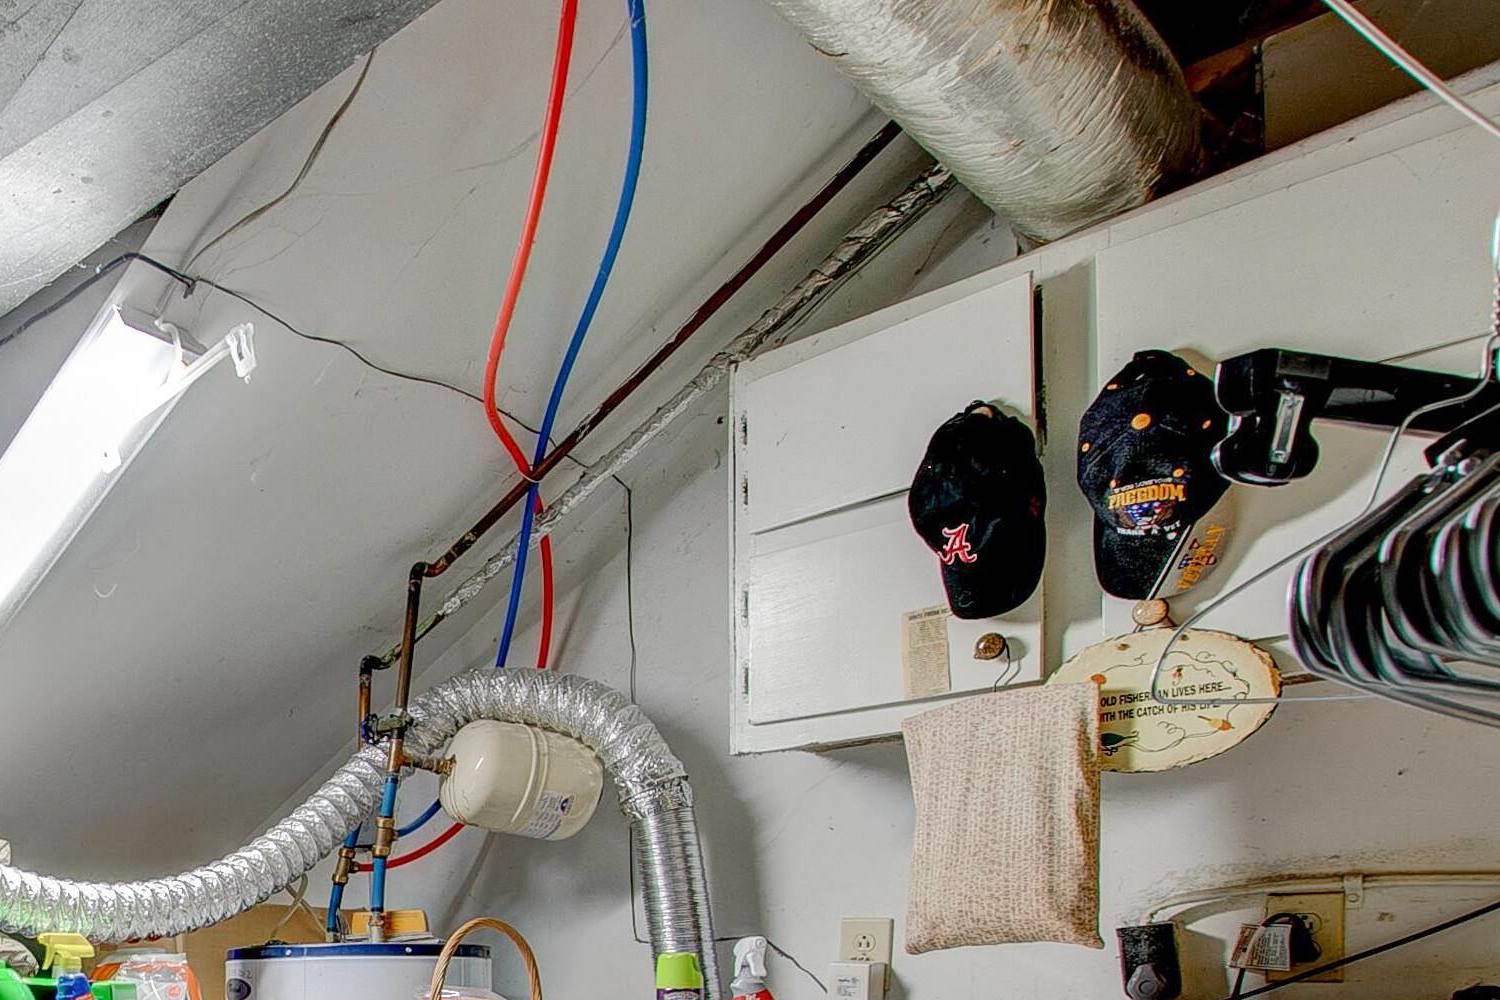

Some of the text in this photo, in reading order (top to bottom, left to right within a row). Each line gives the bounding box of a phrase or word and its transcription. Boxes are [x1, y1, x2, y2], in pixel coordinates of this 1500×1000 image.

[1108, 483, 1187, 510] FREEDOM
[1100, 695, 1117, 707] OLD
[1119, 688, 1169, 705] FISHERAN
[1171, 685, 1196, 697] LIVES
[1100, 711, 1116, 723] ITH
[1118, 708, 1135, 720] THE
[1137, 705, 1164, 718] CATCH
[1167, 703, 1179, 713] OF
